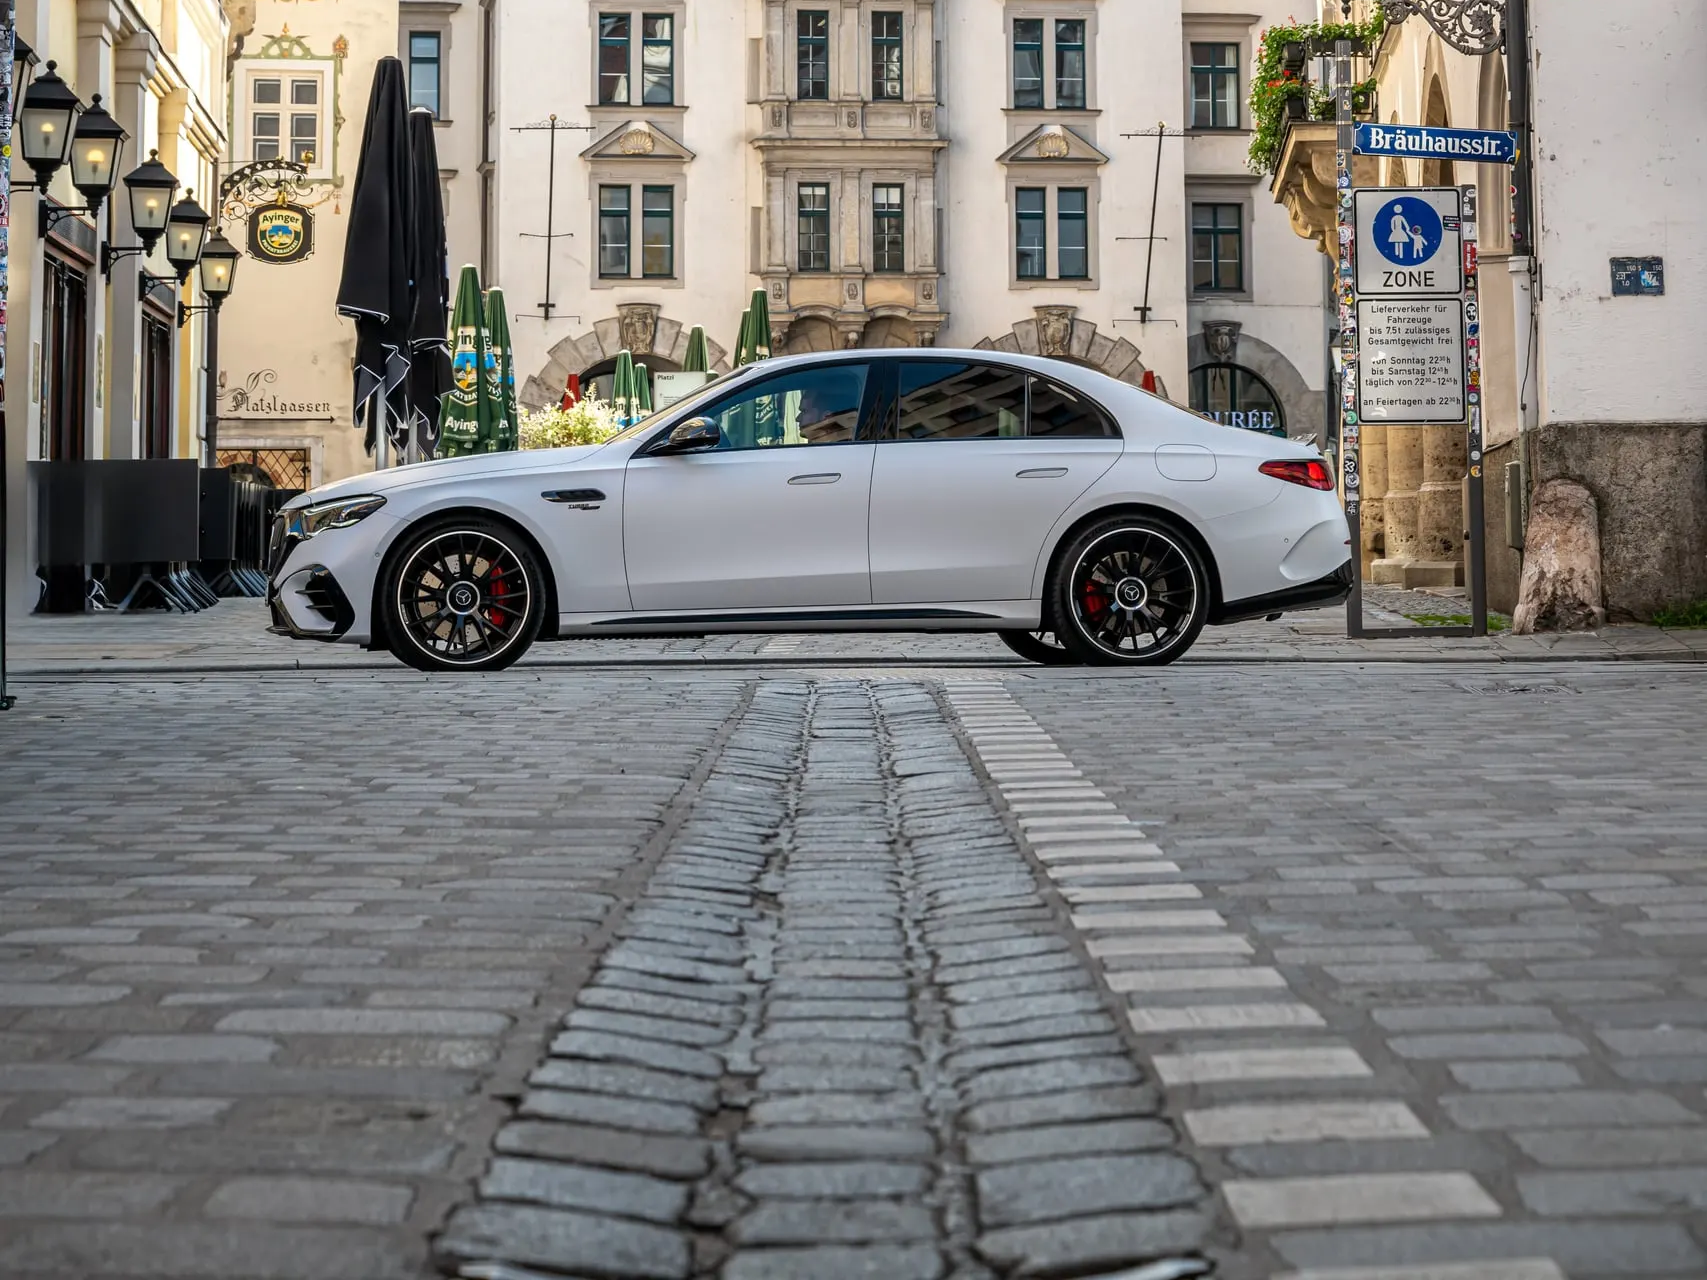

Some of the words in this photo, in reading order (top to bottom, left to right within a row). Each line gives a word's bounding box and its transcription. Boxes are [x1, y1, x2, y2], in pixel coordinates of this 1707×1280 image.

[1369, 127, 1502, 157] Bräuhausstr.
[262, 212, 300, 224] Ayinger
[1382, 271, 1435, 288] ZONE
[1371, 305, 1431, 314] Lieferverkehr
[1434, 304, 1447, 313] für
[1387, 316, 1432, 325] Fahrzeuge
[1369, 327, 1382, 335] bis
[1405, 326, 1451, 336] zulässiges
[1367, 337, 1434, 347] Gesamtgewicht
[1438, 337, 1453, 345] frei
[1390, 356, 1426, 366] Sonntag
[1371, 367, 1384, 376] bis
[1388, 367, 1426, 377] Samstag
[1365, 378, 1394, 388] täglich
[1376, 397, 1423, 407] Feiertagen
[1426, 397, 1436, 406] ab
